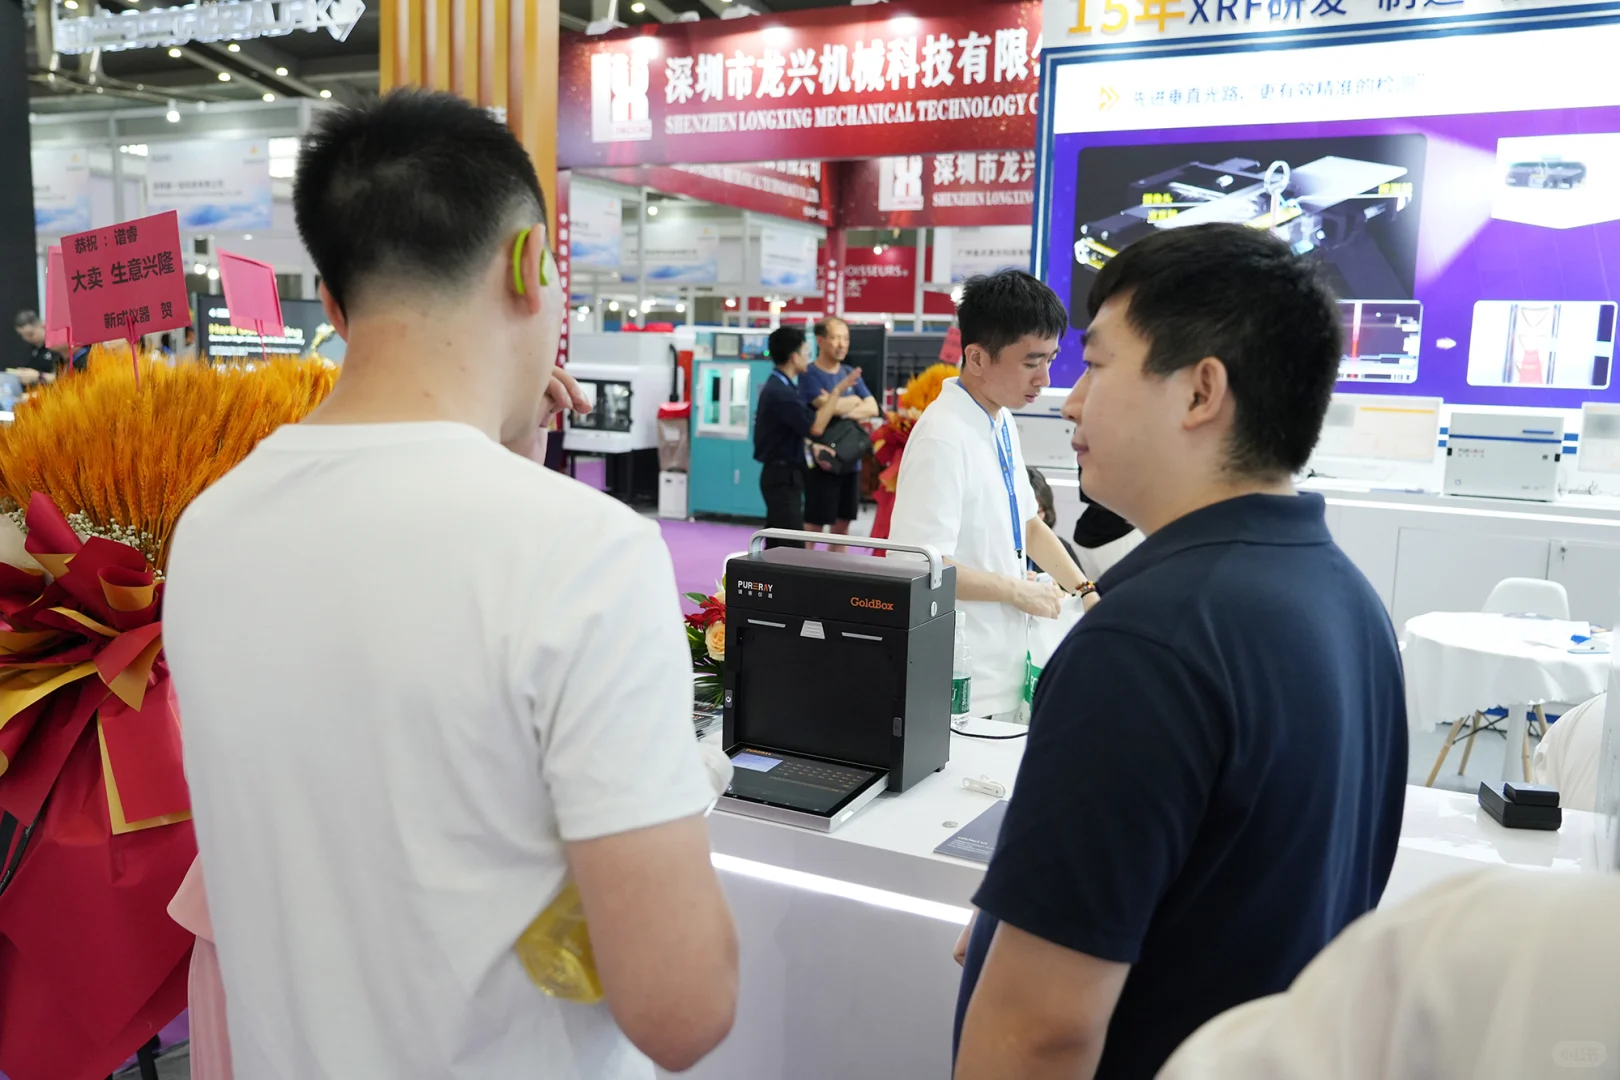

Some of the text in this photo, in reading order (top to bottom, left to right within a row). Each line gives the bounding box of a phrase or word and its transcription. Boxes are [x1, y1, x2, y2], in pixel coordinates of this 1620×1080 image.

[664, 27, 1042, 104] 深圳市龙兴机械科技有限
[665, 112, 737, 135] SHENZHEN
[739, 108, 813, 131] LONGXING
[814, 101, 914, 128] MECHANICAL
[916, 92, 1028, 122] TECHNOLOGY
[71, 250, 175, 293] 大卖 生意兴隆
[104, 301, 173, 329] 新成仪器 贺
[737, 580, 774, 593] PURERAY
[850, 596, 895, 611] GoldBox
